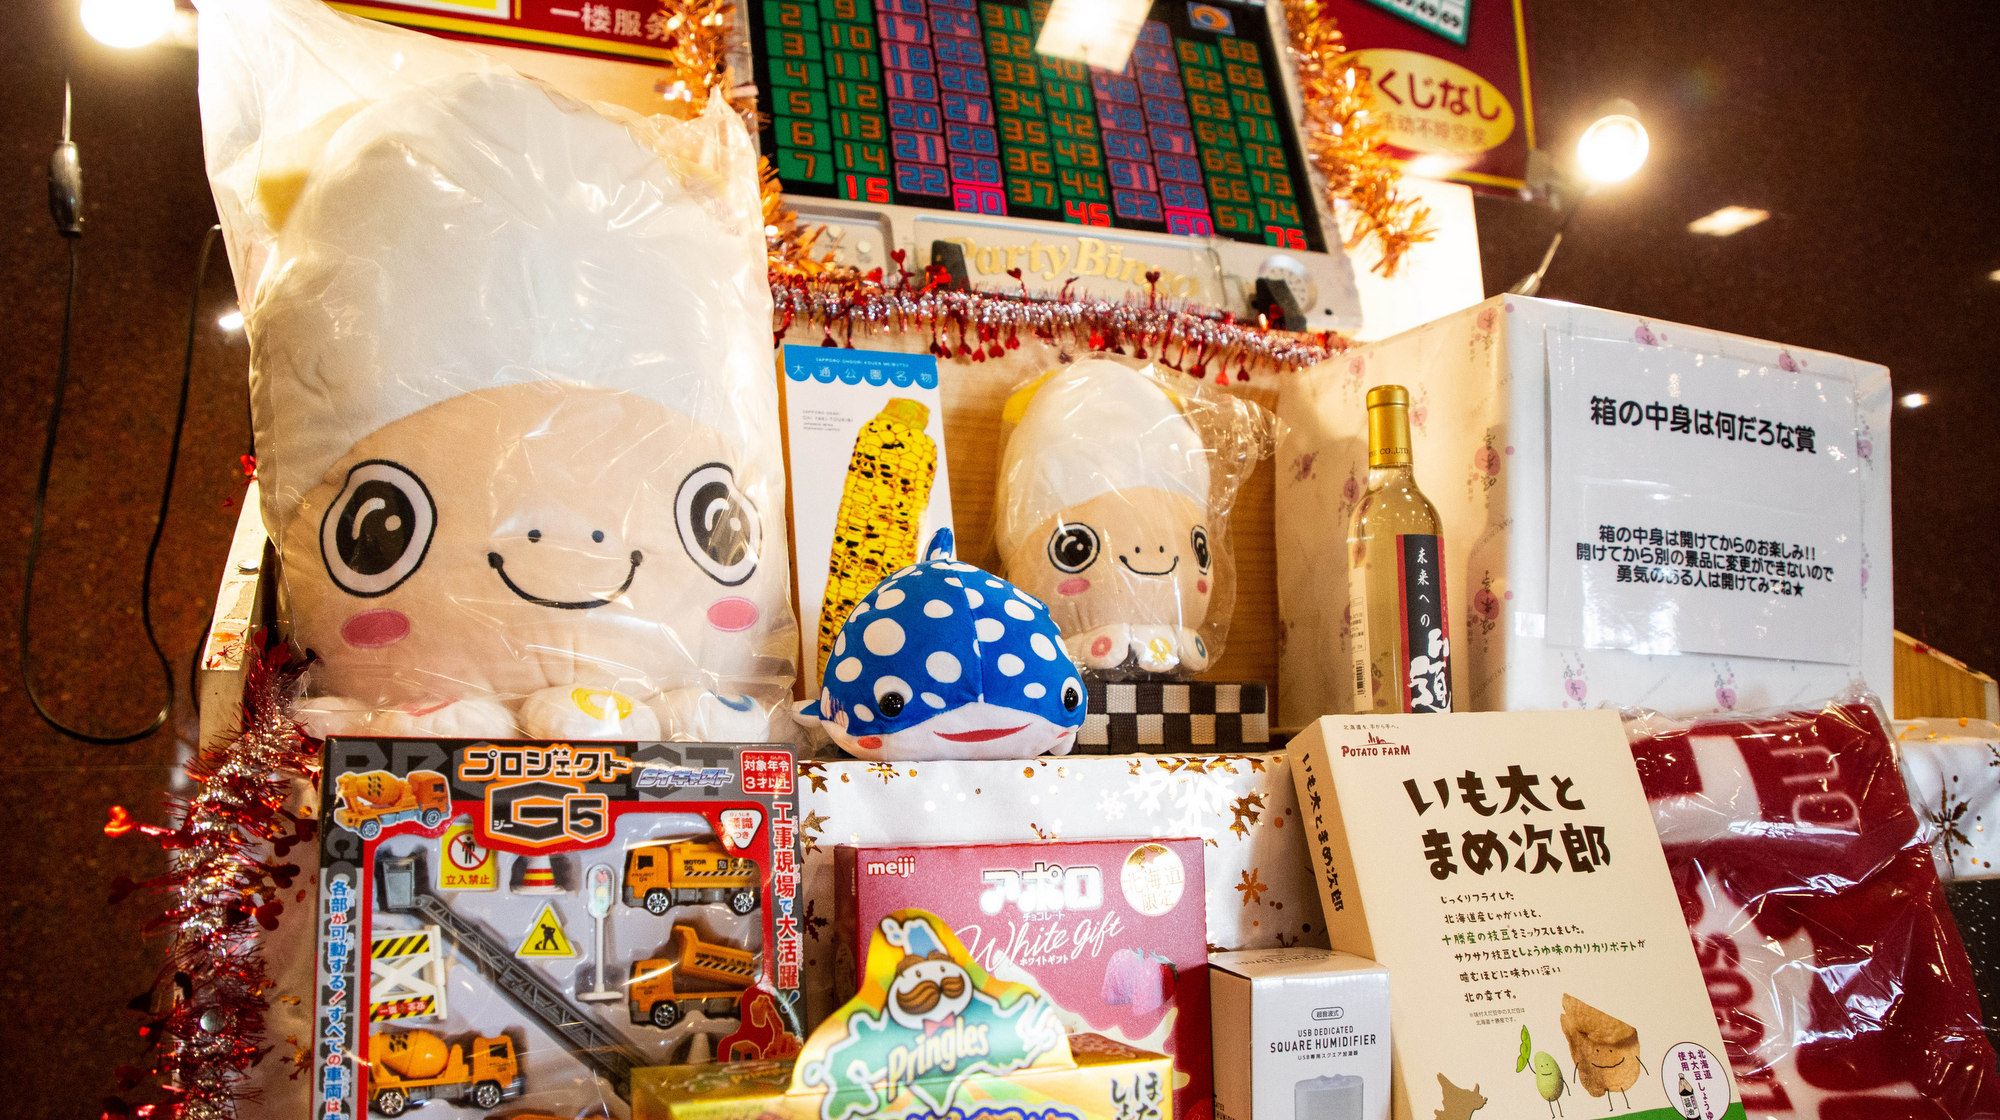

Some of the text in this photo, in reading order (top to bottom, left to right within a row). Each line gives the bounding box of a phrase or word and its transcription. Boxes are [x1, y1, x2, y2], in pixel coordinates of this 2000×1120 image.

[781, 4, 802, 27] 2
[885, 16, 925, 41] 17
[933, 10, 977, 36] 24
[984, 4, 1022, 30] 31
[782, 33, 805, 56] 3
[830, 24, 872, 49] 10
[989, 31, 1032, 59] 32
[889, 45, 930, 70] 18
[938, 38, 982, 63] 25
[1135, 45, 1175, 72] 54
[1178, 41, 1214, 66] 61
[1219, 37, 1259, 63] 68
[785, 62, 808, 85] 4
[834, 53, 869, 78] 11
[993, 59, 1037, 87] 33
[1042, 55, 1084, 81] 40
[1225, 63, 1266, 89] 69
[893, 73, 934, 99] 19
[942, 66, 986, 92] 26
[1095, 77, 1138, 103] 48
[1141, 72, 1182, 98] 55
[1185, 67, 1225, 94] 62
[789, 91, 812, 115] 5
[837, 82, 878, 108] 12
[997, 88, 1043, 115] 34
[1046, 82, 1085, 108] 41
[1231, 88, 1273, 116] 70
[1355, 66, 1501, 121] くじなし
[892, 103, 938, 130] 20
[945, 95, 989, 122] 27
[1100, 105, 1143, 131] 49
[1146, 101, 1188, 126] 56
[1191, 94, 1231, 120] 63
[792, 121, 814, 146] 6
[840, 112, 882, 139] 13
[1002, 117, 1047, 145] 35
[1051, 111, 1095, 138] 42
[1196, 122, 1239, 148] 64
[1239, 115, 1274, 141] 71
[895, 134, 936, 161] 21
[950, 126, 995, 153] 28
[1106, 133, 1149, 160] 50
[1152, 128, 1192, 153] 57
[794, 153, 815, 178] 7
[843, 144, 885, 172] 14
[1006, 147, 1052, 175] 36
[1056, 140, 1100, 167] 43
[1203, 148, 1245, 175] 65
[1245, 142, 1286, 169] 72
[899, 166, 946, 193] 22
[953, 157, 999, 184] 29
[1111, 162, 1150, 189] 51
[1157, 156, 1199, 182] 58
[845, 175, 890, 204] 15
[1011, 178, 1054, 206] 37
[1061, 170, 1105, 198] 44
[1209, 176, 1251, 203] 66
[1252, 169, 1293, 197] 73
[957, 188, 1004, 216] 30
[1116, 191, 1161, 219] 52
[1163, 183, 1206, 211] 59
[1065, 200, 1111, 228] 45
[1215, 205, 1256, 231] 67
[1258, 197, 1301, 225] 74
[1169, 213, 1211, 238] 60
[1264, 225, 1307, 251] 75
[793, 364, 933, 385] 大通公園名物
[1590, 395, 1817, 454] 箱の中身は何だろな賞
[1576, 541, 1835, 582] 開けてから別の景品に変更ができないので
[461, 746, 632, 779] プロジェクト
[1341, 745, 1411, 757] POTATO FARM
[744, 759, 790, 772] 対象年令
[745, 776, 791, 790] 3才以上
[1402, 764, 1586, 817] いも太と
[492, 820, 514, 830] ジー
[1302, 752, 1344, 911] いも太とまめ次郎
[1421, 822, 1611, 881] まめ次郎
[445, 874, 490, 886] 立入禁止
[867, 857, 916, 878] meiji
[979, 862, 1103, 914] アポロ
[1440, 890, 1515, 904] じっくりフライした
[1022, 911, 1066, 922] チョコレート
[1444, 908, 1542, 924] 北海道産じゃがいもと、
[954, 922, 1068, 971] White
[1454, 939, 1646, 963] サクサク枝豆としょうゆ味のカリカリポテトが
[1019, 953, 1069, 967] ホワイトギフト
[1459, 965, 1561, 983] 噛むほどに味わい深い
[1463, 988, 1517, 1003] 北の幸です。
[1270, 1034, 1377, 1053] SQUARE HUMIDIFIER
[1297, 1025, 1354, 1038] USB DEDICATED
[887, 1016, 989, 1102] Pringles
[1677, 1051, 1690, 1072] 使用
[1697, 1049, 1713, 1080] 北海道
